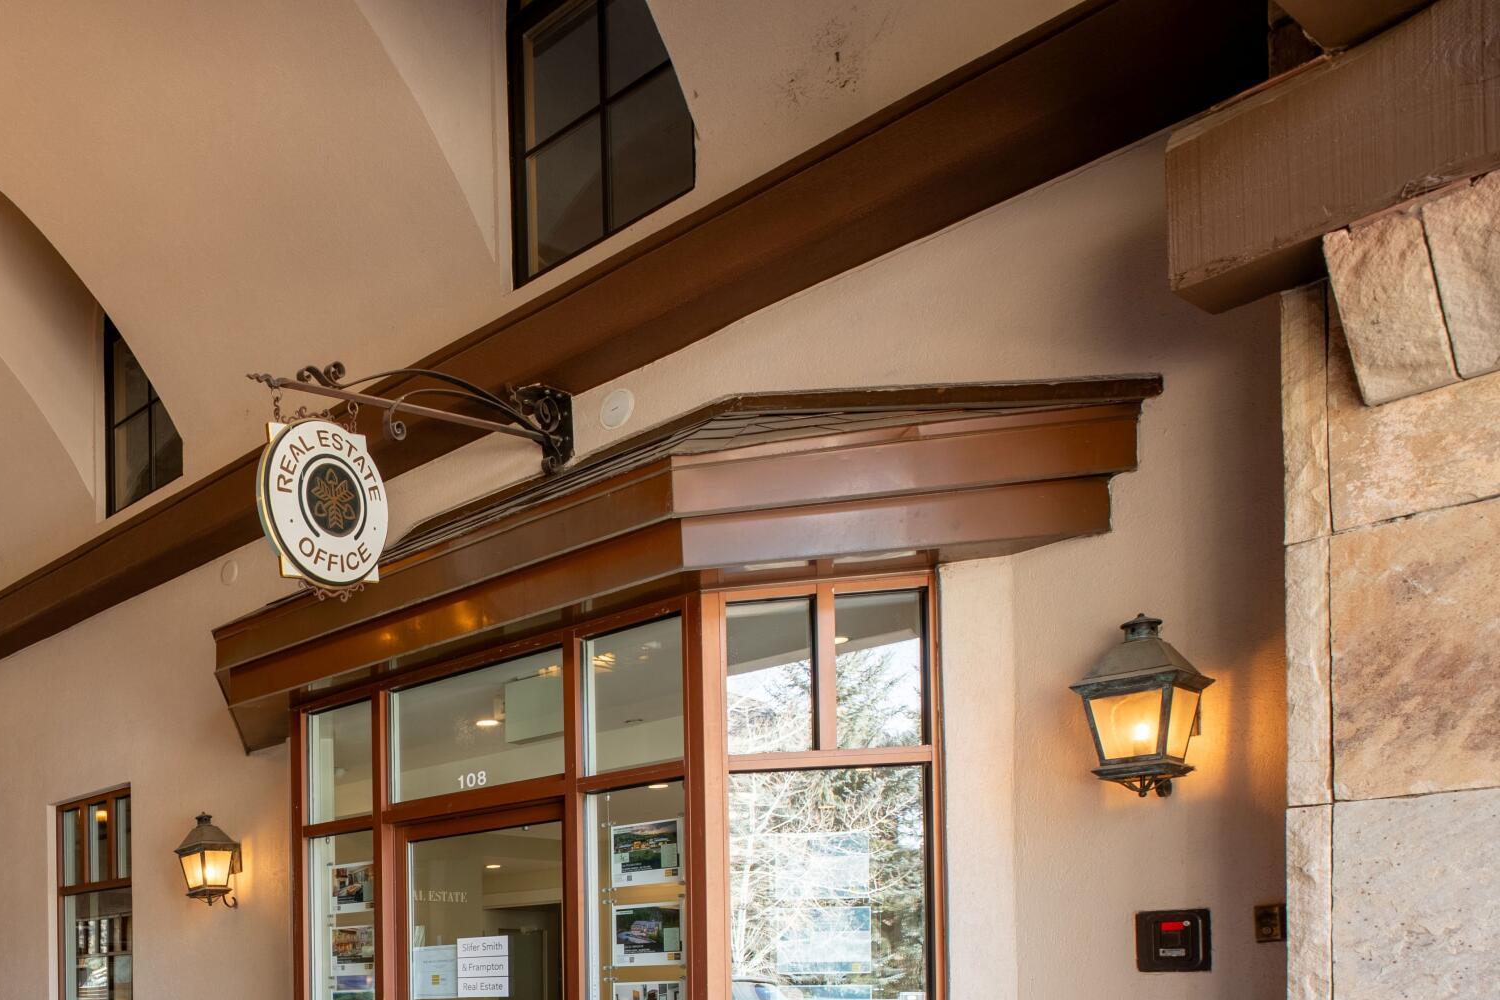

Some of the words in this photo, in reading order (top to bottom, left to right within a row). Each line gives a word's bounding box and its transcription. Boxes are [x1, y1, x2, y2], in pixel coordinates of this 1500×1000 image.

[277, 435, 315, 493] REAL
[316, 430, 382, 502] ESTATE
[299, 536, 372, 573] OFFICE
[457, 770, 487, 789] 108
[428, 889, 468, 903] ESTATE
[462, 943, 481, 952] Slifer
[482, 941, 503, 951] Smith
[462, 964, 468, 972] &
[468, 962, 504, 973] Frampton
[462, 982, 478, 991] Real
[480, 982, 503, 991] Estate
